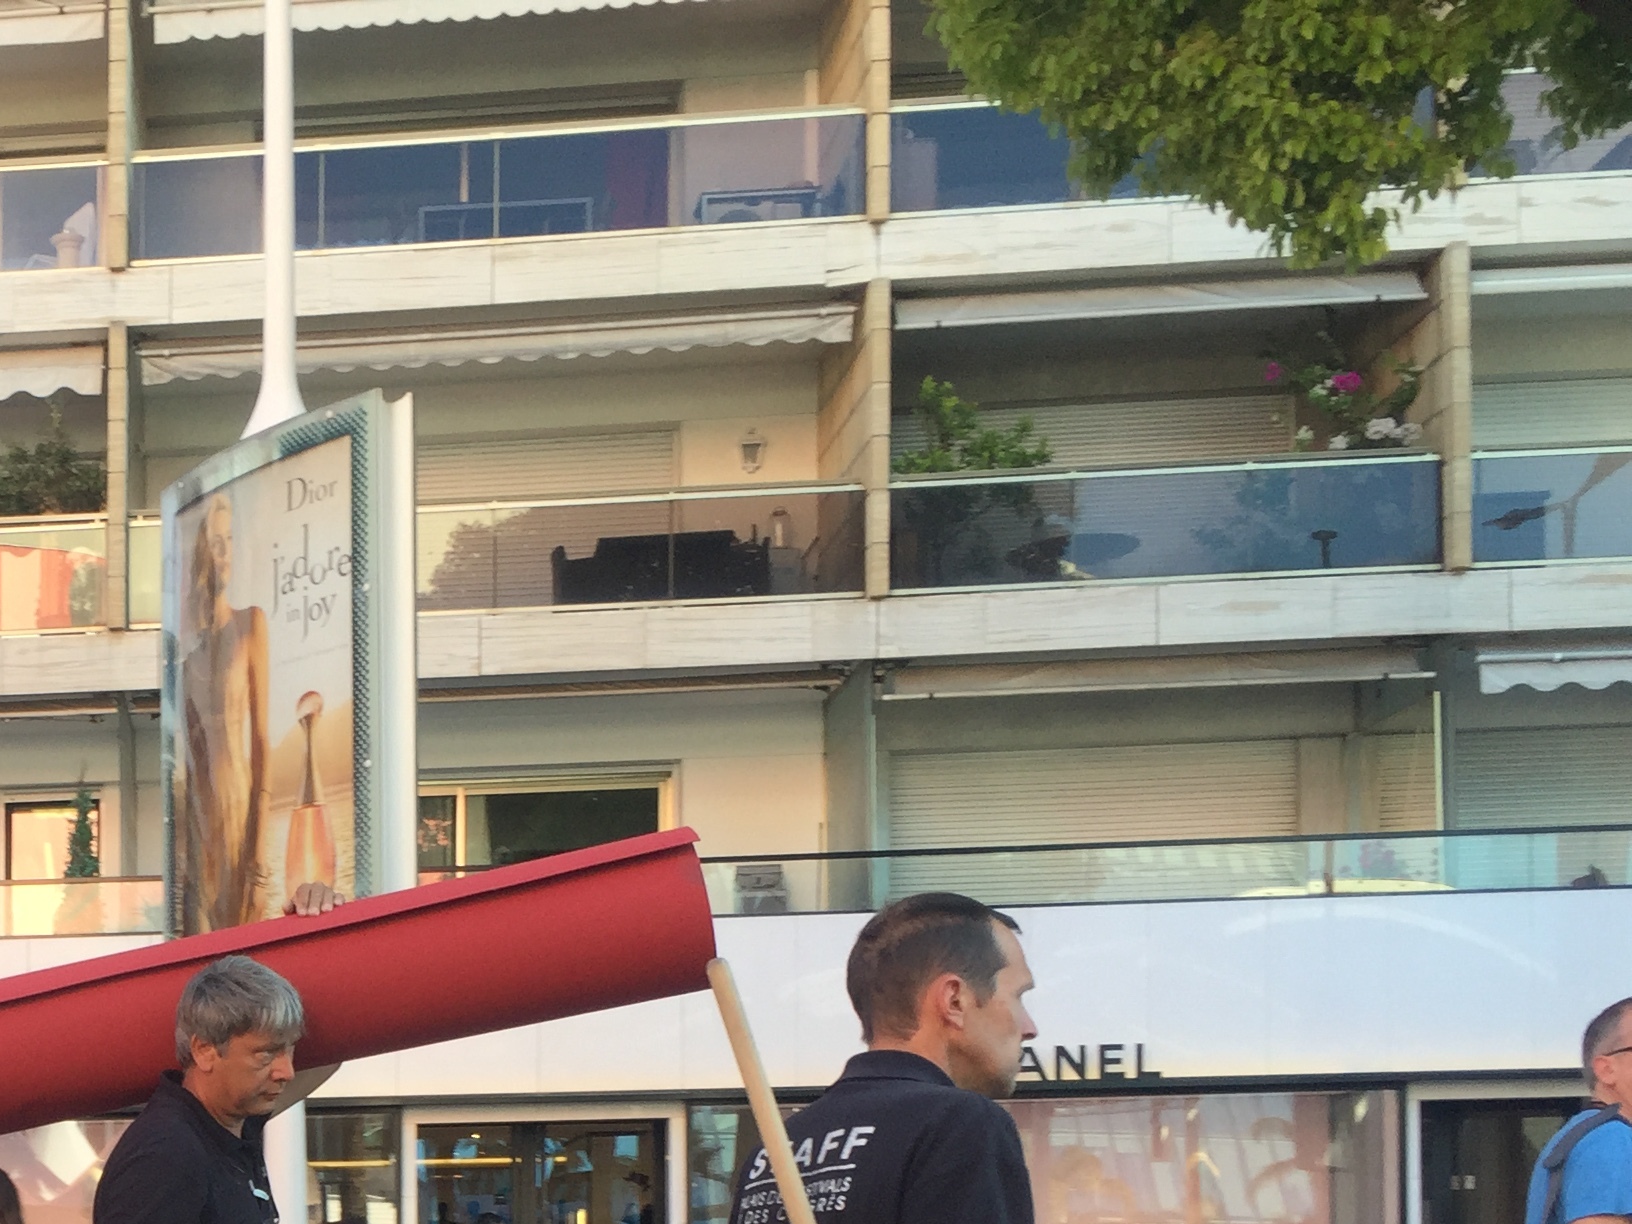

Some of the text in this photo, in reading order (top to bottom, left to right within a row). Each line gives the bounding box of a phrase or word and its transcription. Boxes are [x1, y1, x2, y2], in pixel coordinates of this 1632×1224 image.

[286, 477, 338, 512] Dior
[286, 586, 337, 643] in joy
[1019, 1043, 1162, 1080] ANEL
[749, 1126, 876, 1179] SAFF
